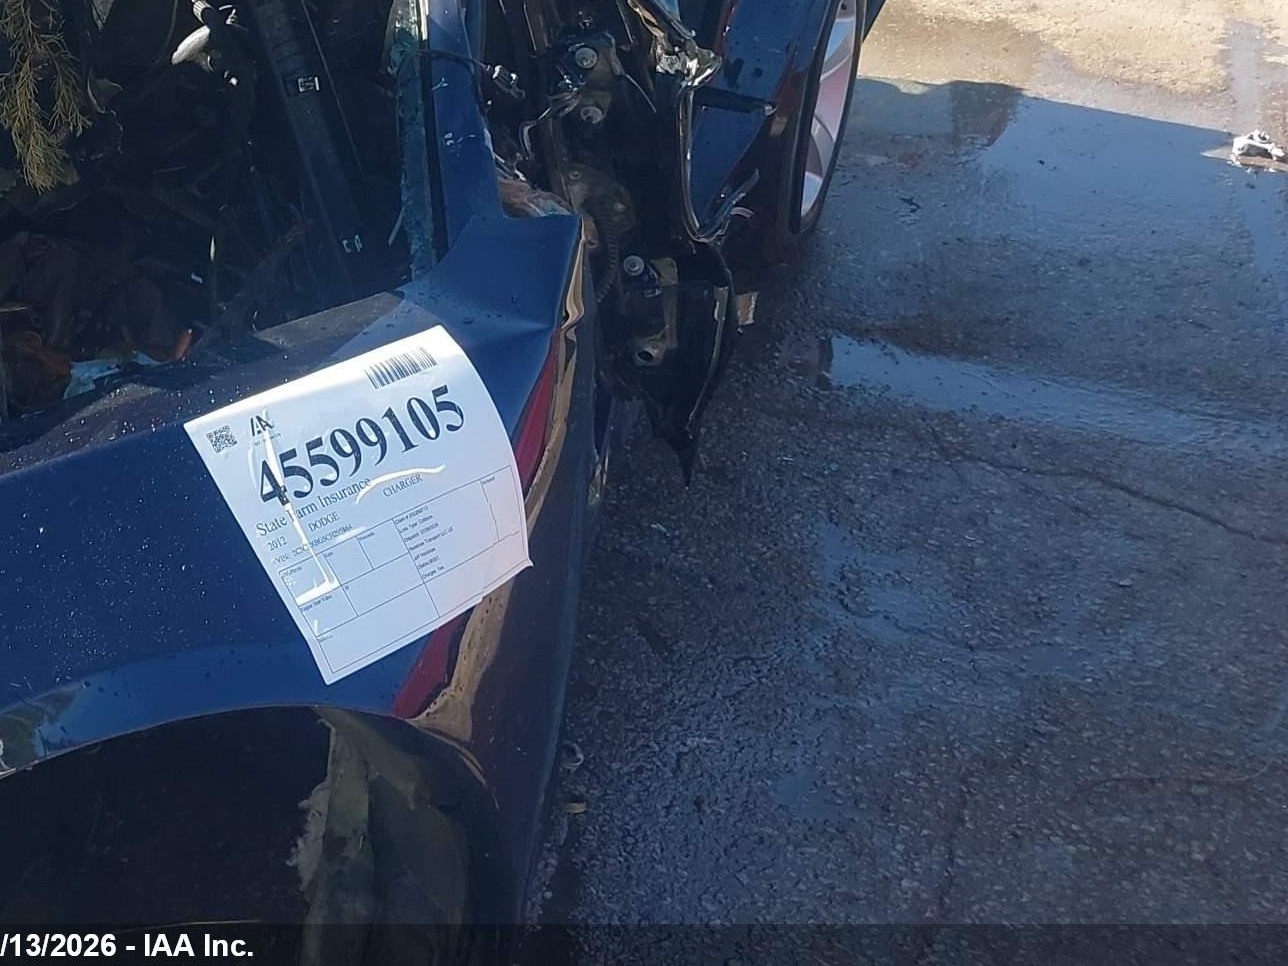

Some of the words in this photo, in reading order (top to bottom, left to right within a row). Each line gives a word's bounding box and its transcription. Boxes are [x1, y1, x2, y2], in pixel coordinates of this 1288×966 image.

[259, 384, 464, 507] 45599105
[255, 513, 288, 536] State
[318, 477, 371, 509] Insurance
[266, 535, 289, 551] 2012
[307, 511, 341, 532] DODGE
[382, 474, 423, 497] CHARGER
